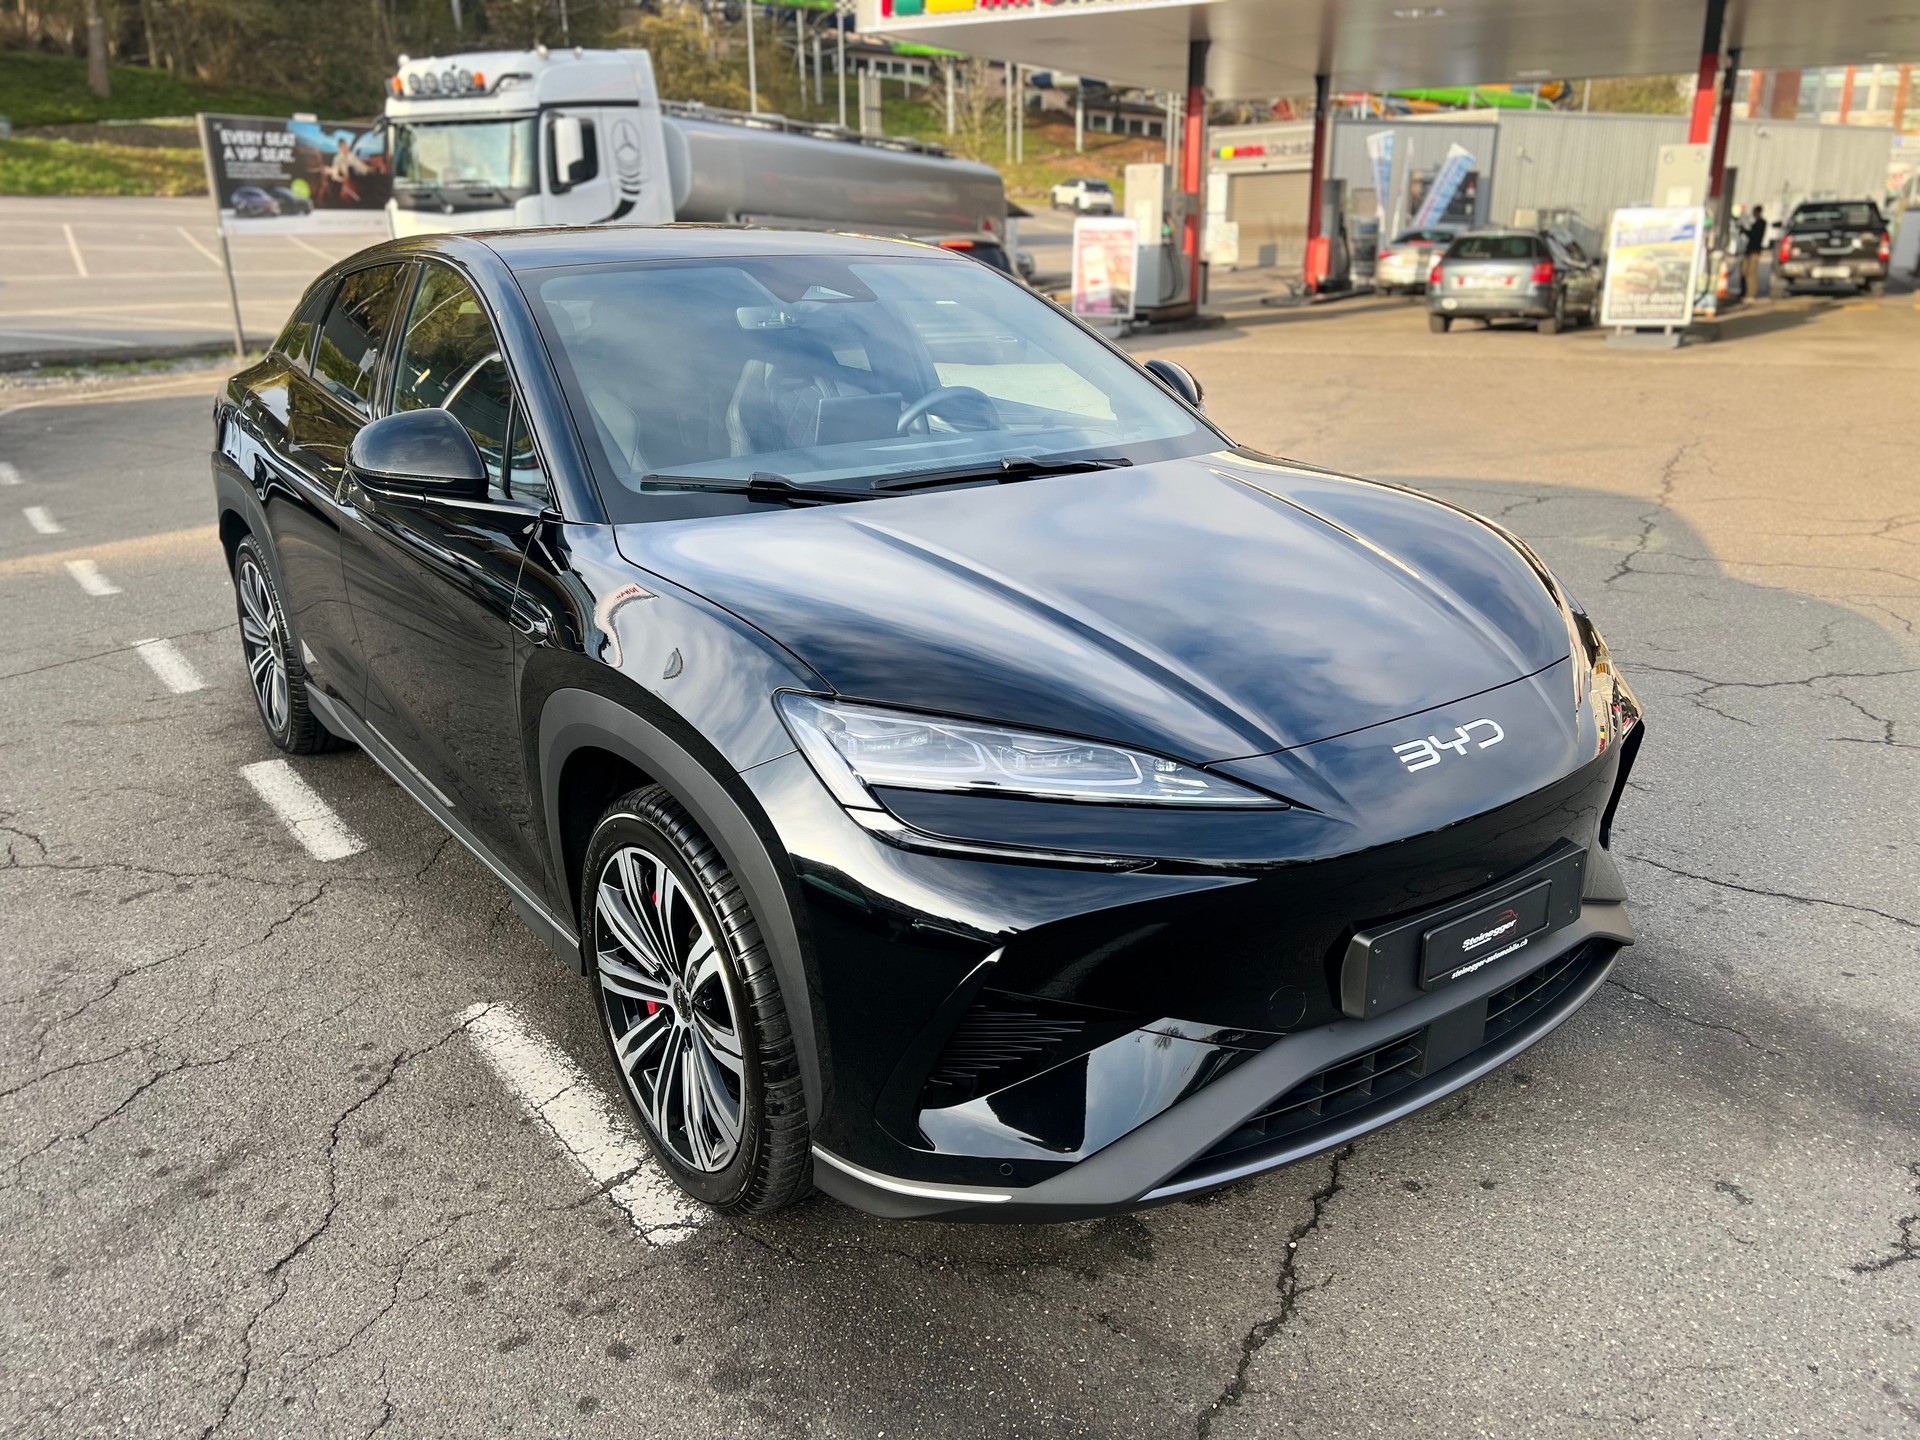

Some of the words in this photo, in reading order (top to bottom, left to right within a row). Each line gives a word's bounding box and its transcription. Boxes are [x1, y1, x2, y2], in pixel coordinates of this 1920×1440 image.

[220, 129, 262, 146] EVERY
[264, 131, 296, 147] SEAT
[223, 145, 236, 161] A
[235, 146, 259, 161] VIP
[261, 147, 296, 163] SEAT.
[1392, 718, 1505, 773] BYD
[1462, 919, 1517, 949] Steinegger
[1451, 938, 1529, 980] steinegger-automobile.ch
